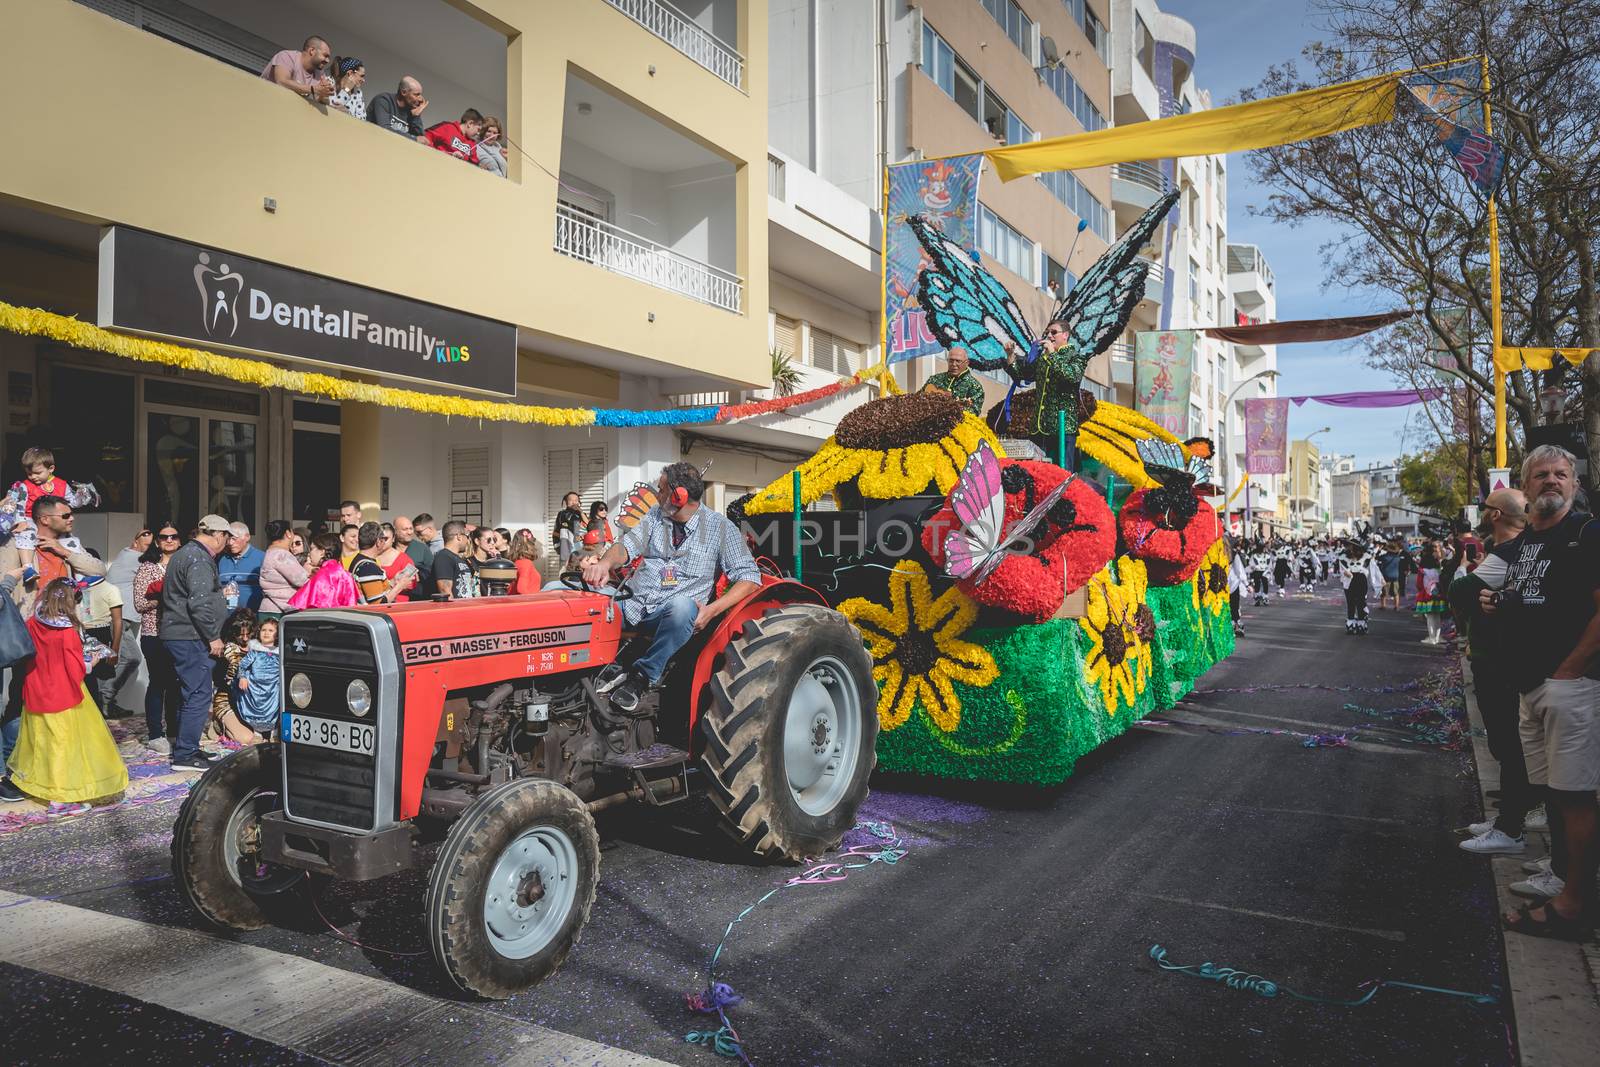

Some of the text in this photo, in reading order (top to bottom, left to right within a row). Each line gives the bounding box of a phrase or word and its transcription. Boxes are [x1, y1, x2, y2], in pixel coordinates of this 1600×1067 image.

[249, 288, 436, 360] DentalFamily
[436, 345, 470, 362] KIDS
[405, 644, 442, 659] 240
[450, 637, 499, 654] MASSEY
[510, 630, 566, 648] FERGUSON
